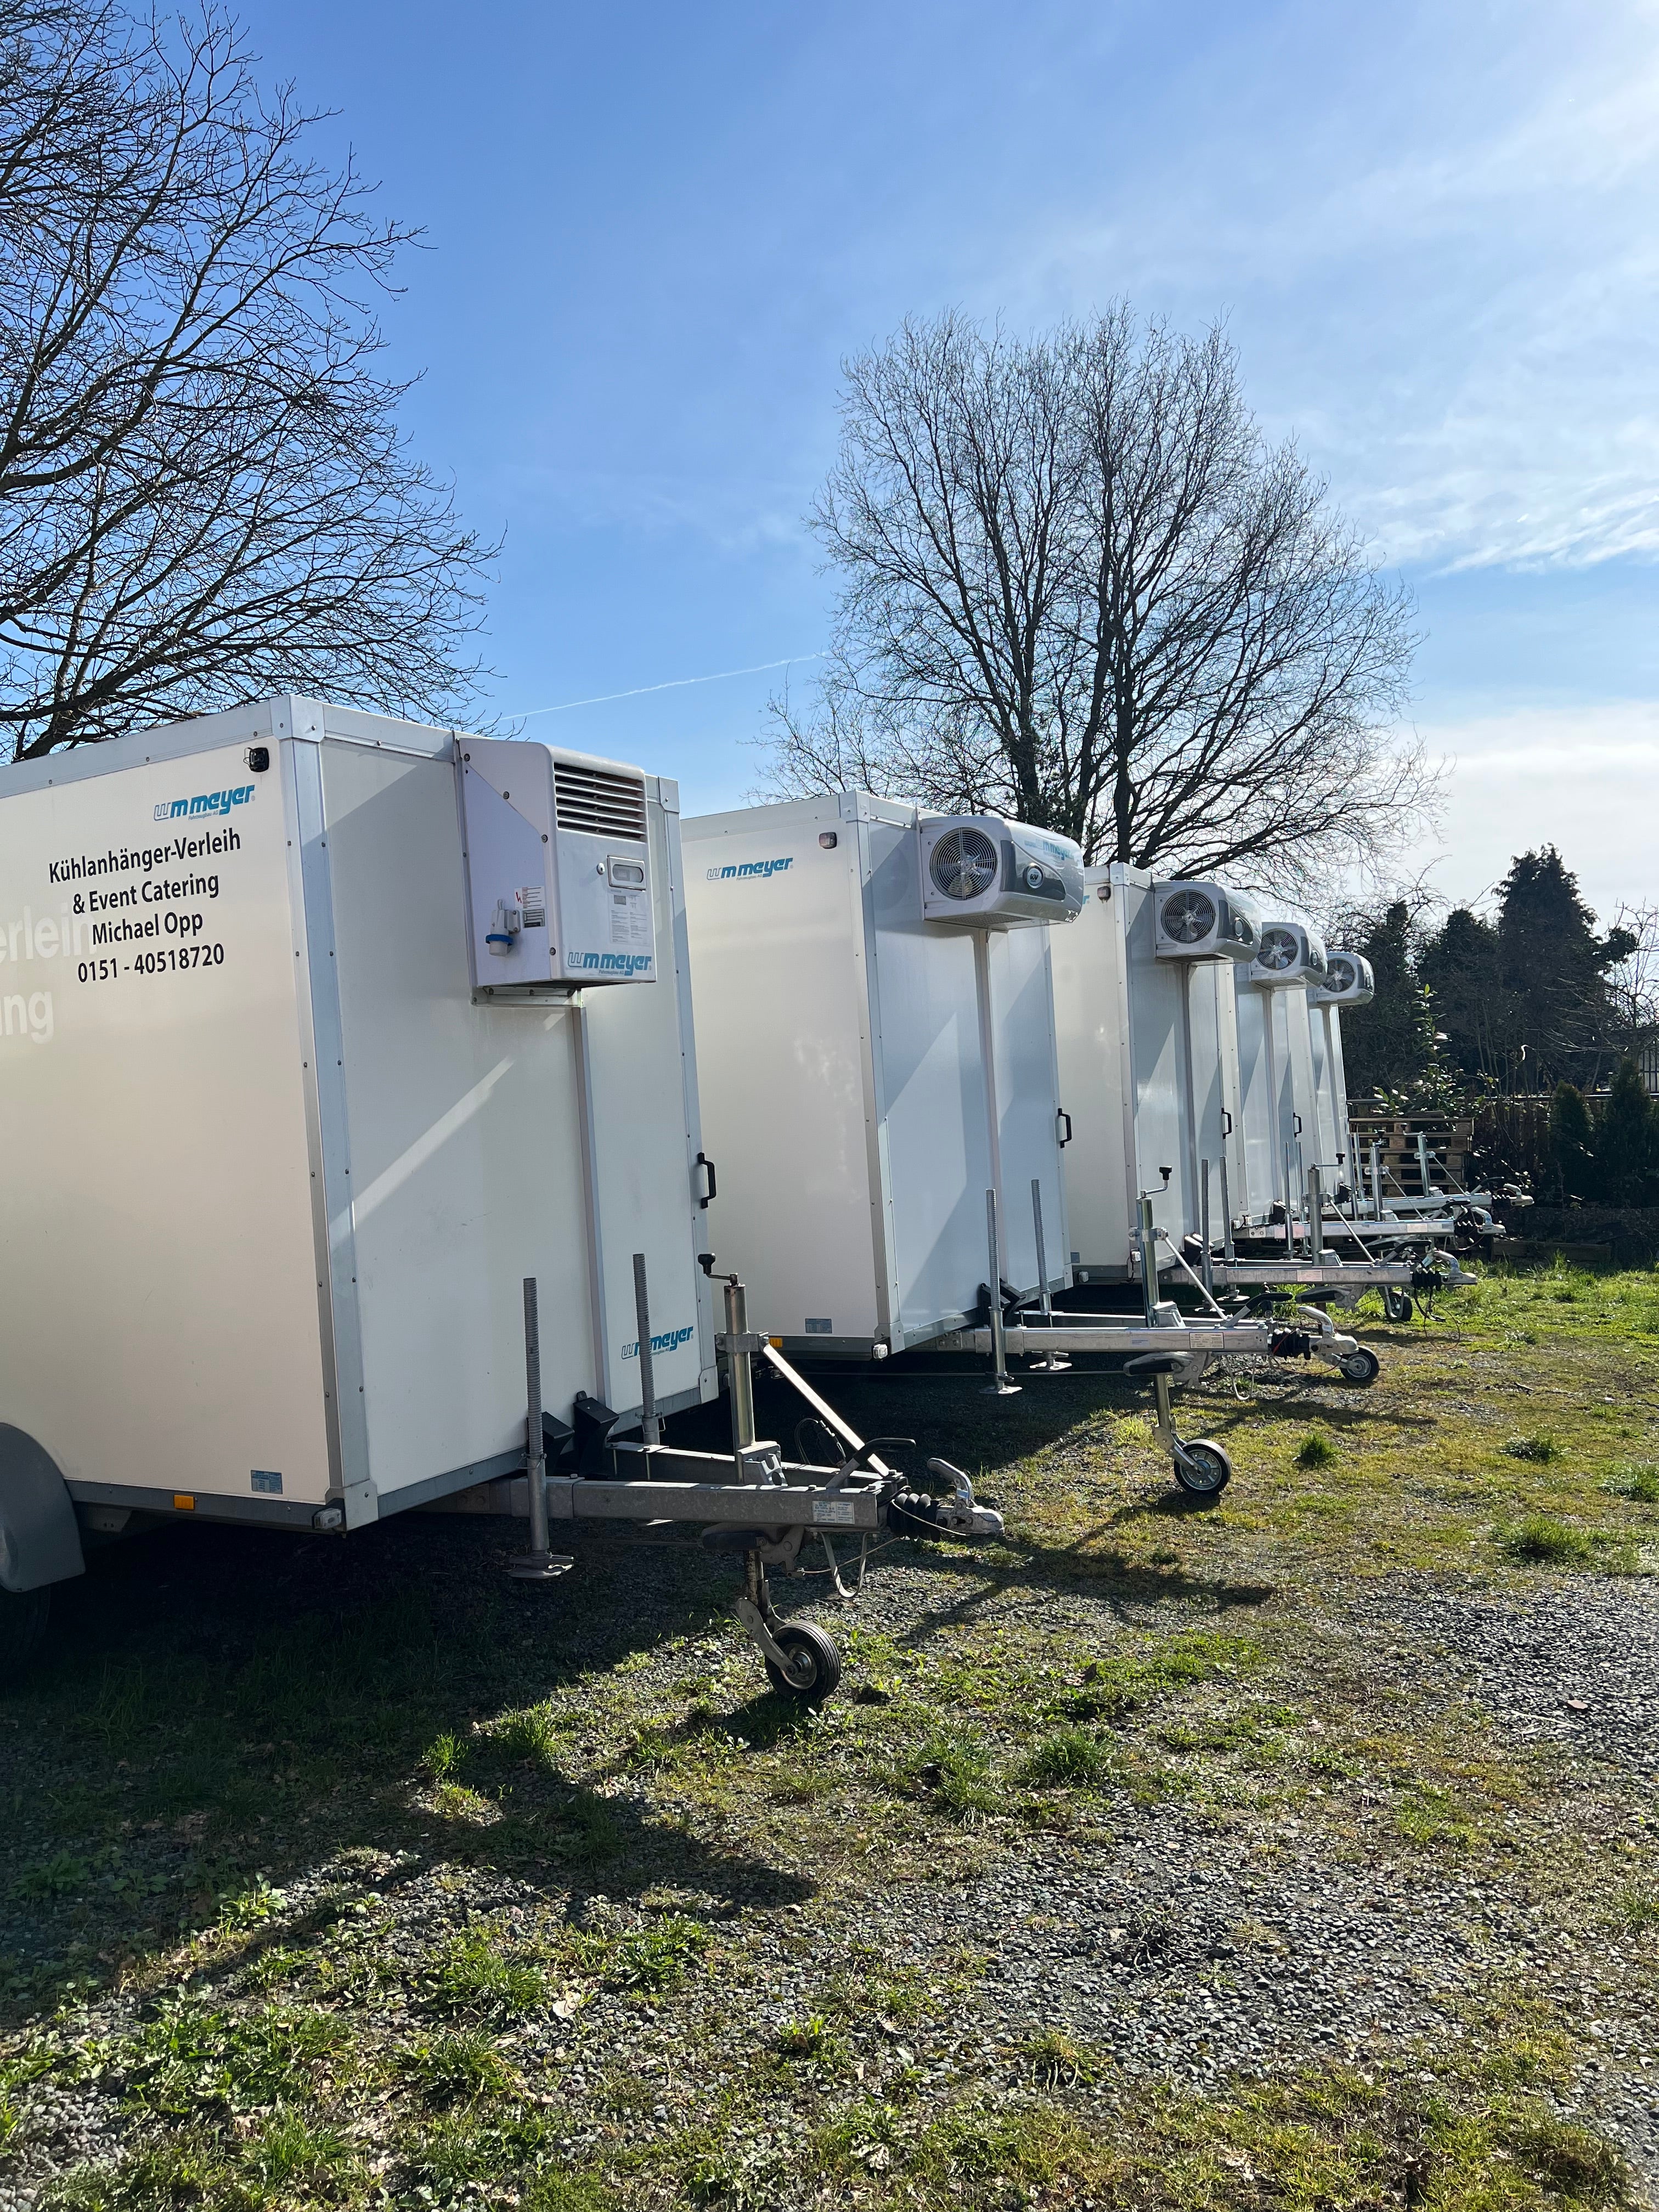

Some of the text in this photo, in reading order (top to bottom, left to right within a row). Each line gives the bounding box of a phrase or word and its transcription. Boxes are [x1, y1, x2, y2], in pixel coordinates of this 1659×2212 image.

[49, 827, 240, 883] Kühlanhänger-Verleih
[73, 873, 219, 915] & Event Catering
[92, 912, 203, 945] Michael Opp
[78, 958, 117, 983] 0151
[134, 943, 224, 974] 40518720
[0, 991, 54, 1045] ng
